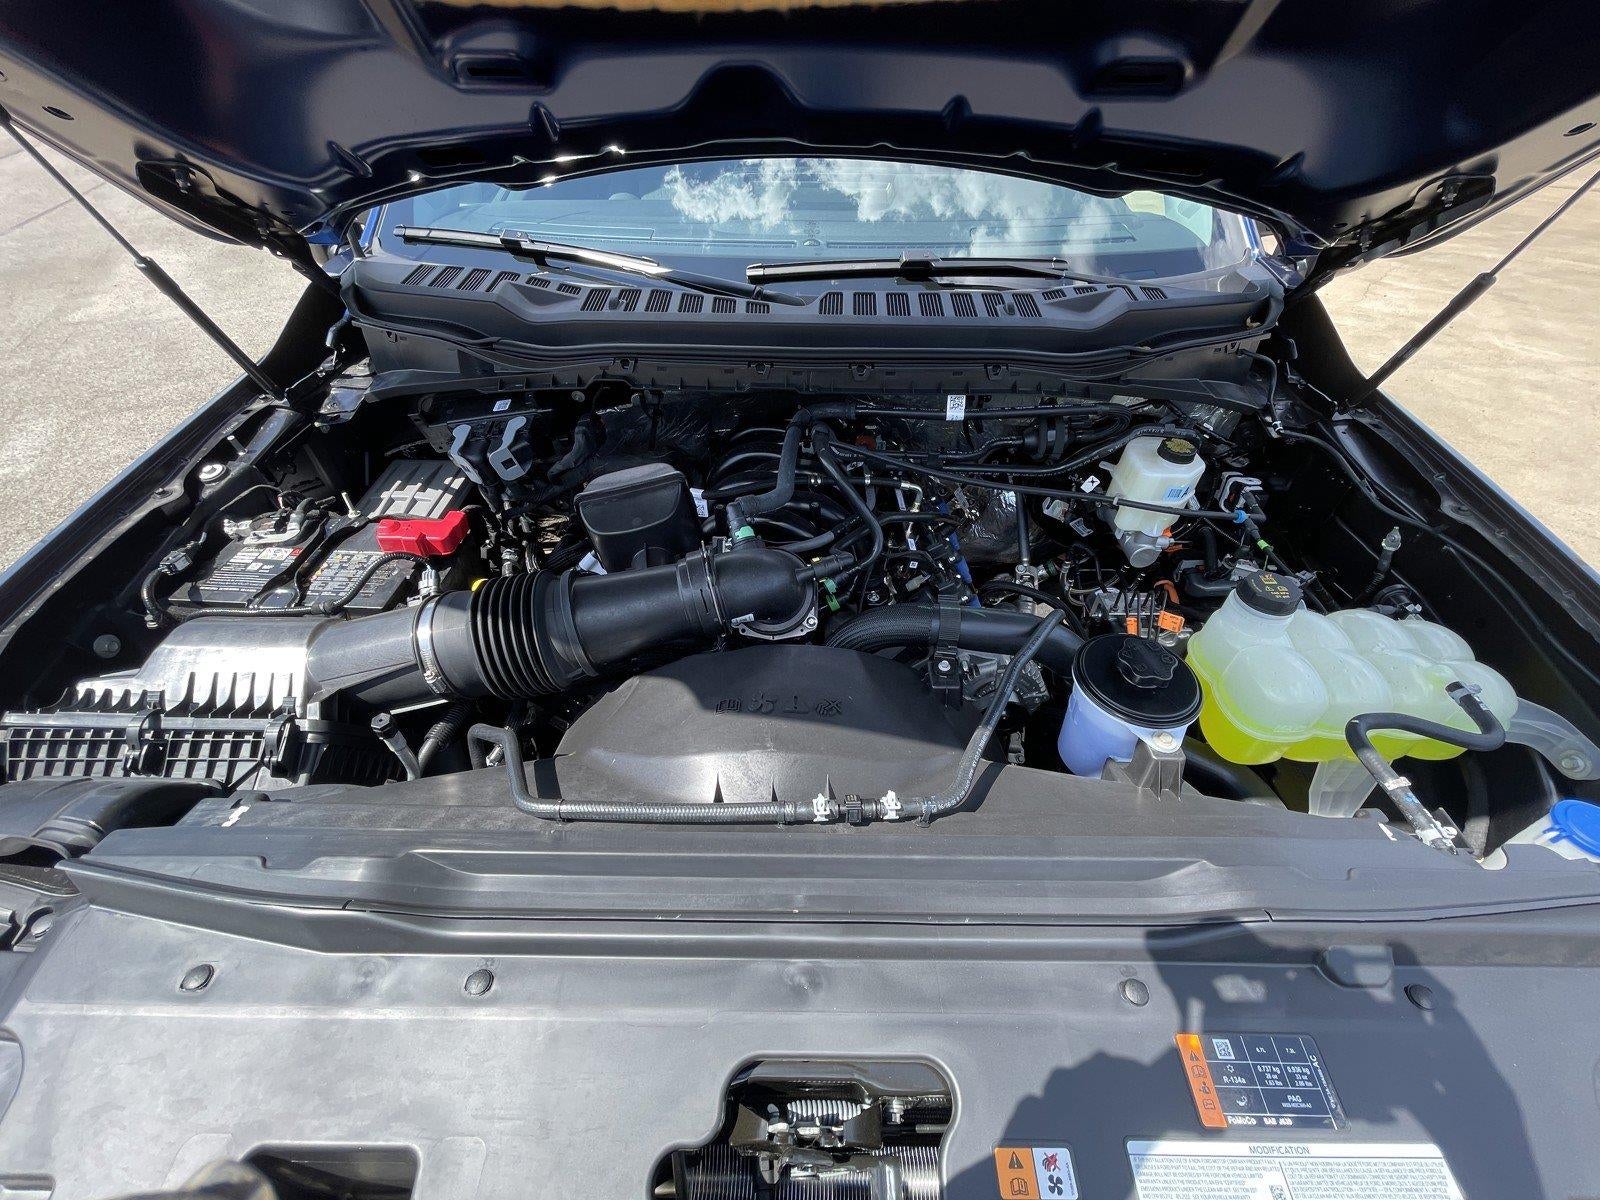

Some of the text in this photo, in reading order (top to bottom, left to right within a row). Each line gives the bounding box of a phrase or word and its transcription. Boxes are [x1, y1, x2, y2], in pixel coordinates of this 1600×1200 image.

[1272, 1066, 1281, 1074] kg
[1302, 1067, 1311, 1075] kg
[1222, 1076, 1247, 1084] R-134a
[1227, 1115, 1257, 1125] FoMoCo
[1248, 1145, 1311, 1155] MODIFICATION
